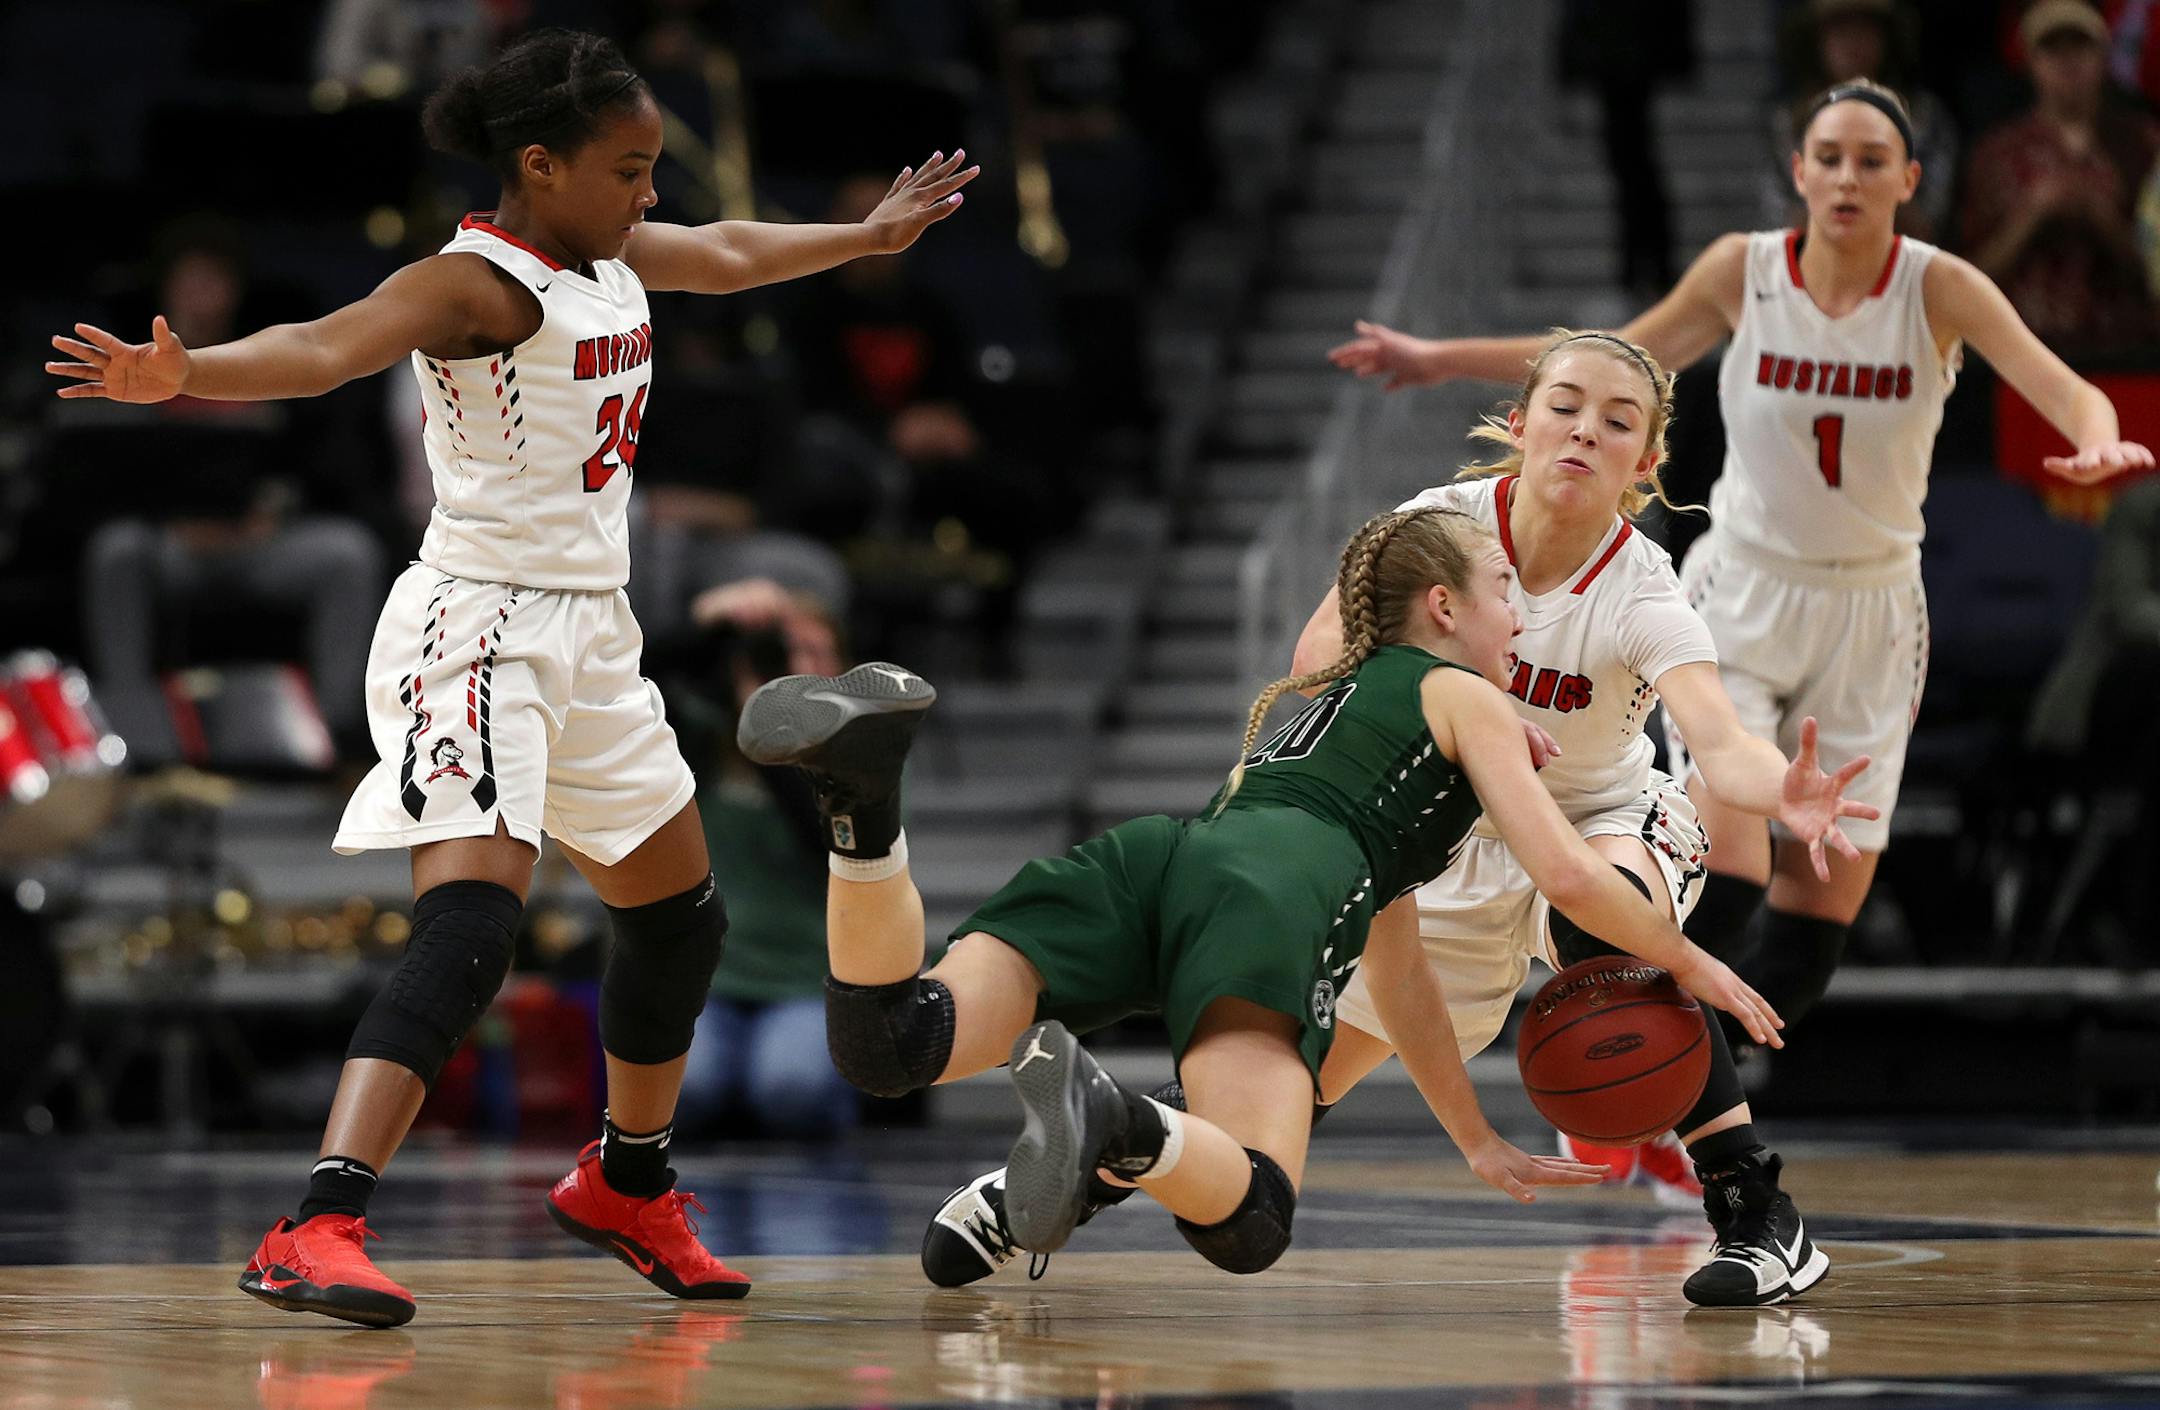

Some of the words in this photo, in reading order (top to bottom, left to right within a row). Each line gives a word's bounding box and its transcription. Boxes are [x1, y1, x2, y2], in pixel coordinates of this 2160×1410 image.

[1757, 350, 1914, 402] MUSTANGS
[582, 382, 649, 492] 24
[1813, 412, 1844, 489] 1
[1508, 652, 1593, 713] ANGS
